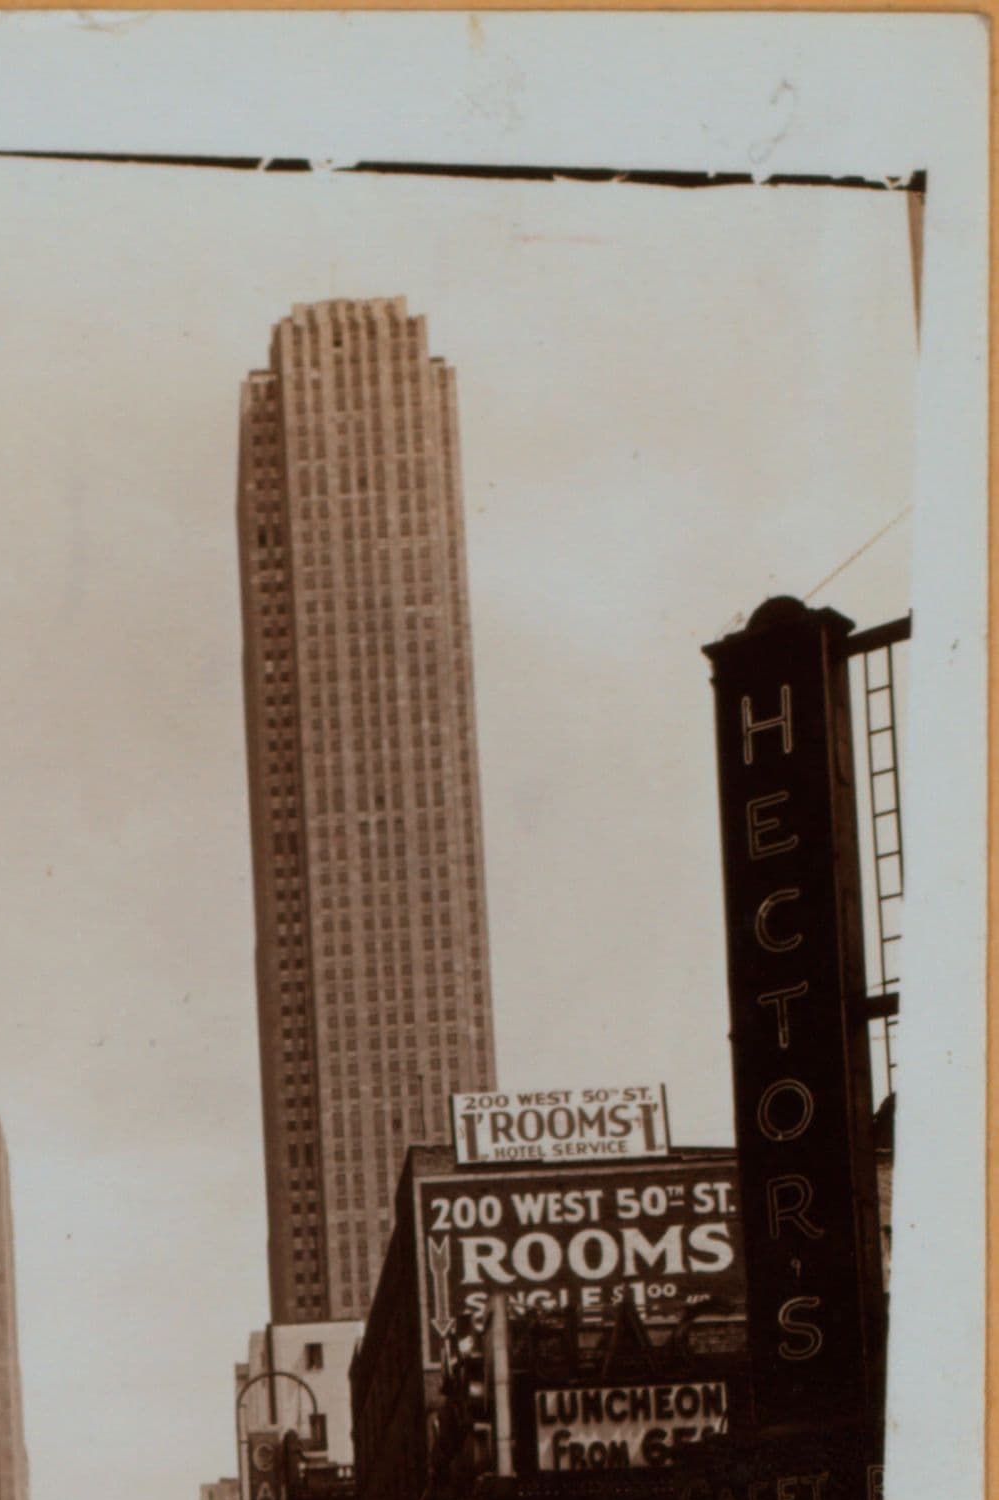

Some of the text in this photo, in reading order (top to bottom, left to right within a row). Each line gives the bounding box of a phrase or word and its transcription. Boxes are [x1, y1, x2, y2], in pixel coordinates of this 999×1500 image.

[739, 684, 823, 1361] HECTOR'S
[462, 1095, 509, 1111] 200
[517, 1090, 572, 1106] WEST
[489, 1104, 632, 1144] ROOMS
[494, 1144, 546, 1160] HOTEL
[552, 1140, 629, 1157] SERVICE
[430, 1196, 502, 1230] 200
[511, 1188, 603, 1223] WEST
[460, 1222, 734, 1285] ROOMS
[464, 1285, 602, 1326] SNGLE
[539, 1384, 723, 1426] LUNCHEON
